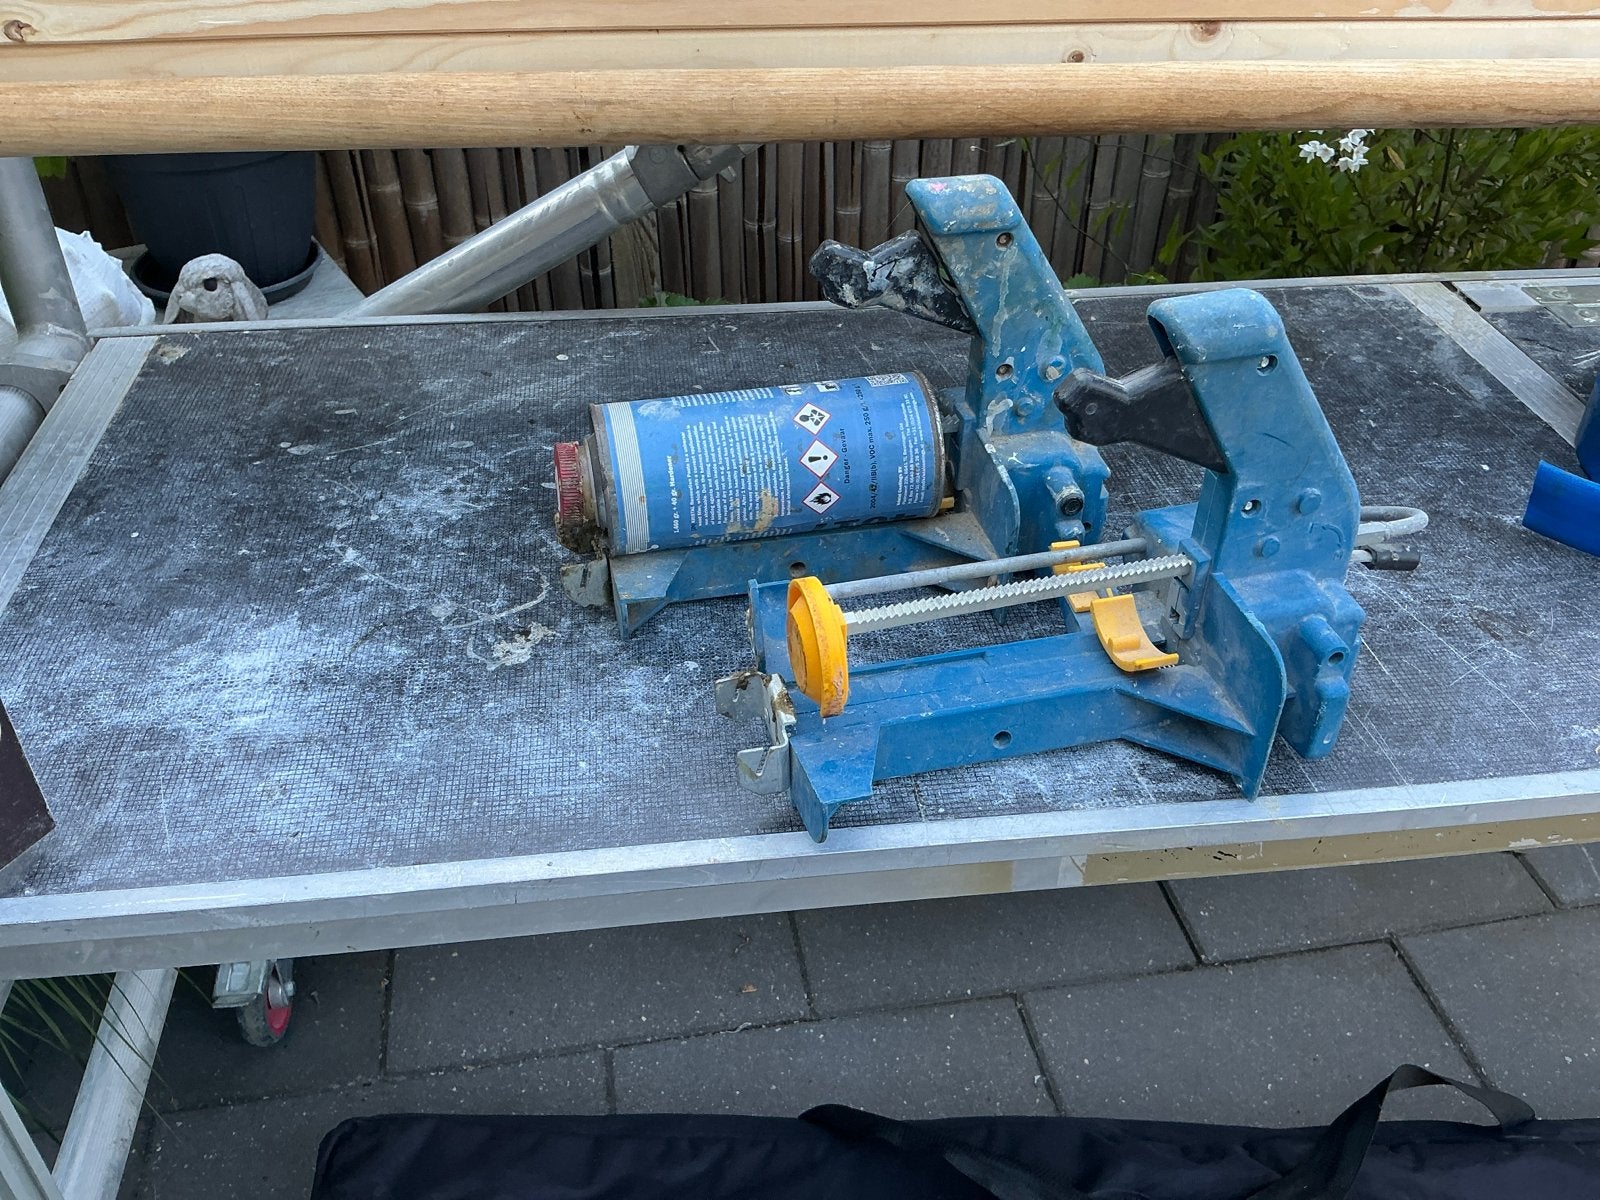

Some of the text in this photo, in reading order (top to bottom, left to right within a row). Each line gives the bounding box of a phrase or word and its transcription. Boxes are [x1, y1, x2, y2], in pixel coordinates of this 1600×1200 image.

[863, 412, 871, 425] 250
[667, 456, 675, 487] Hardener
[671, 497, 677, 505] 40
